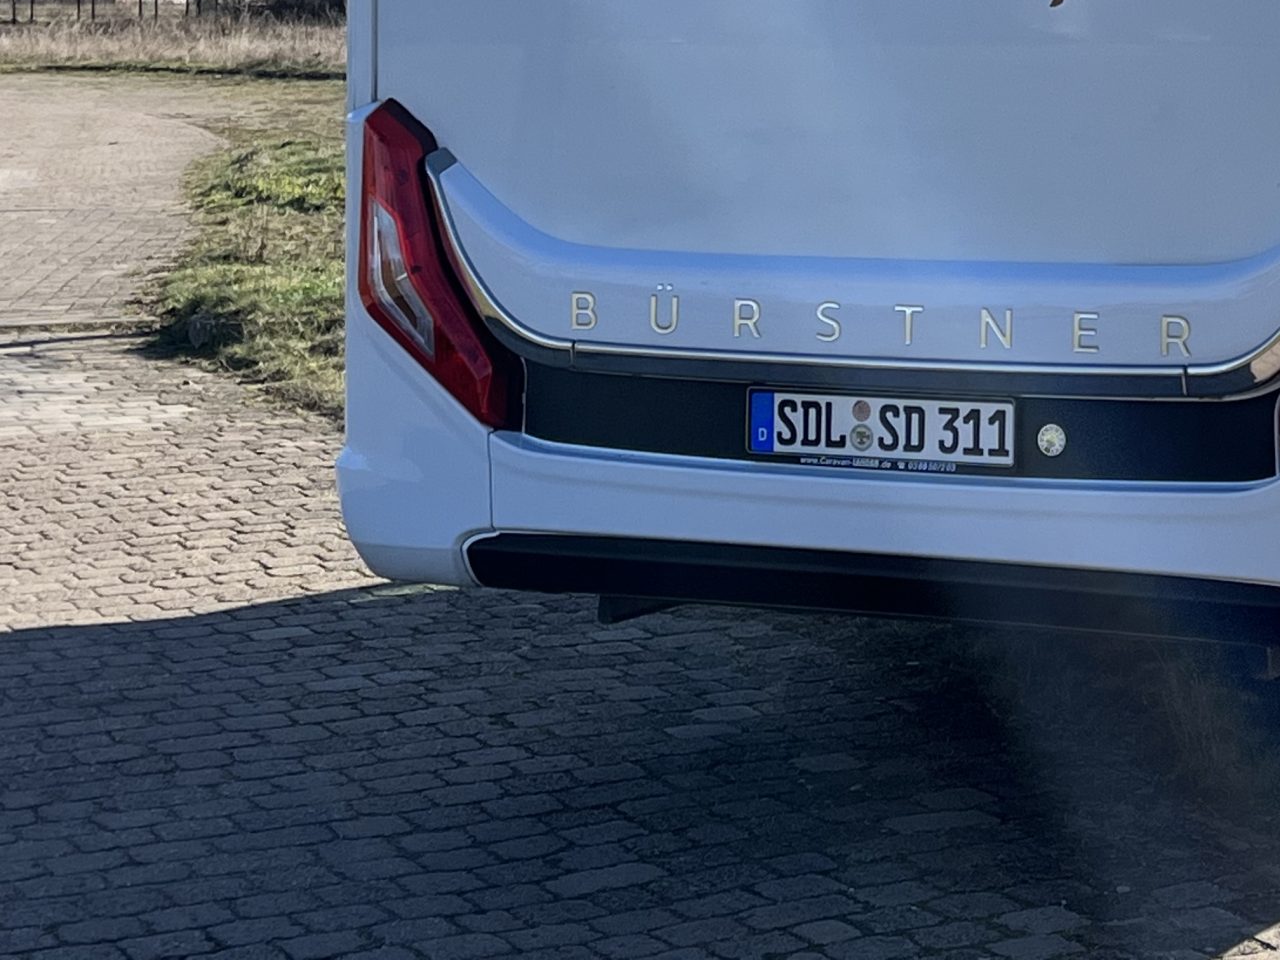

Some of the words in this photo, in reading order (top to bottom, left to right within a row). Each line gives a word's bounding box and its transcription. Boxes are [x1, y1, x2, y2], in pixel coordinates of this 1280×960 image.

[570, 283, 1191, 357] BÜRSTNER
[758, 428, 767, 441] D
[776, 398, 847, 449] SDL
[878, 404, 926, 453] SD
[938, 407, 1010, 458] 311
